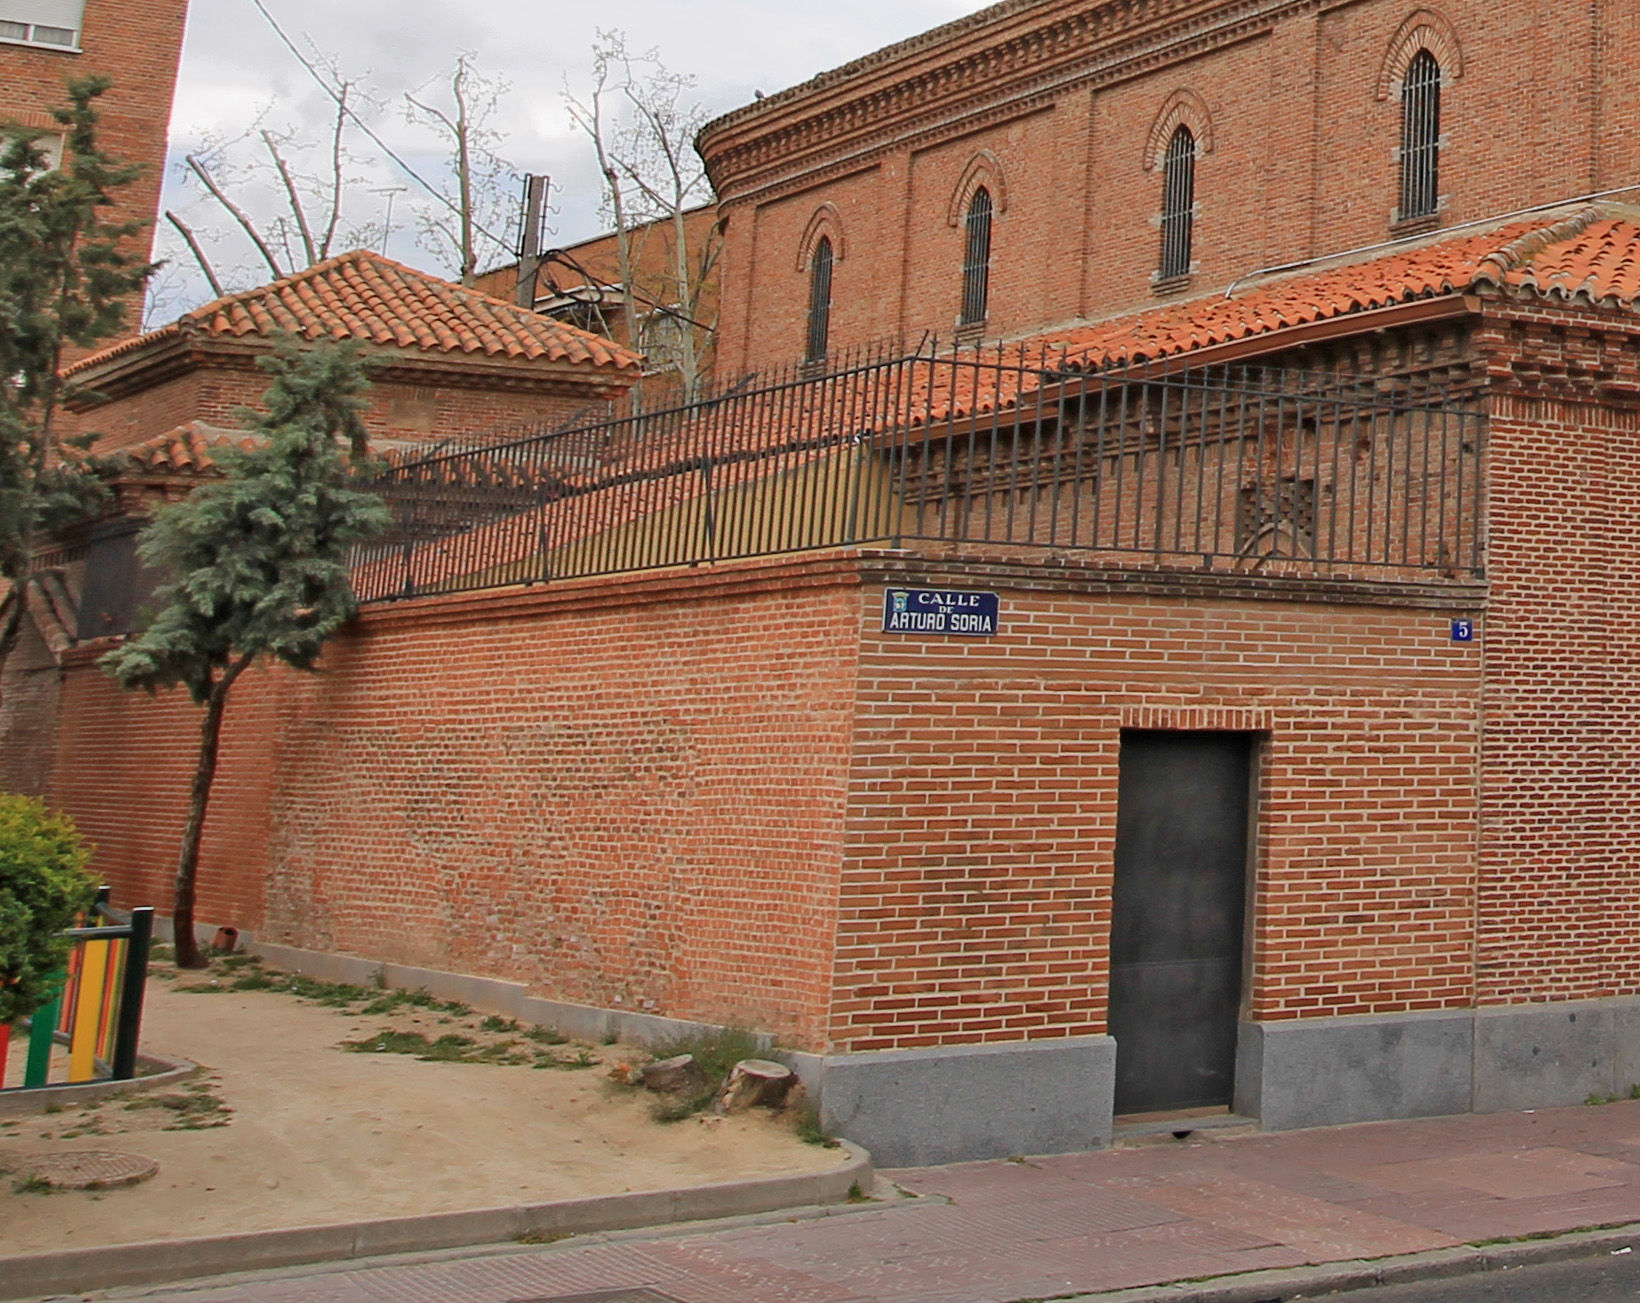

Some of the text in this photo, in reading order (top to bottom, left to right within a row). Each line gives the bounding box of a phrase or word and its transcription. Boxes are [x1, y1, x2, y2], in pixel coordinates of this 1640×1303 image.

[918, 593, 980, 607] CALLE
[939, 606, 954, 614] DE
[890, 612, 992, 632] ARTURO SORIA
[1459, 621, 1469, 638] 5
